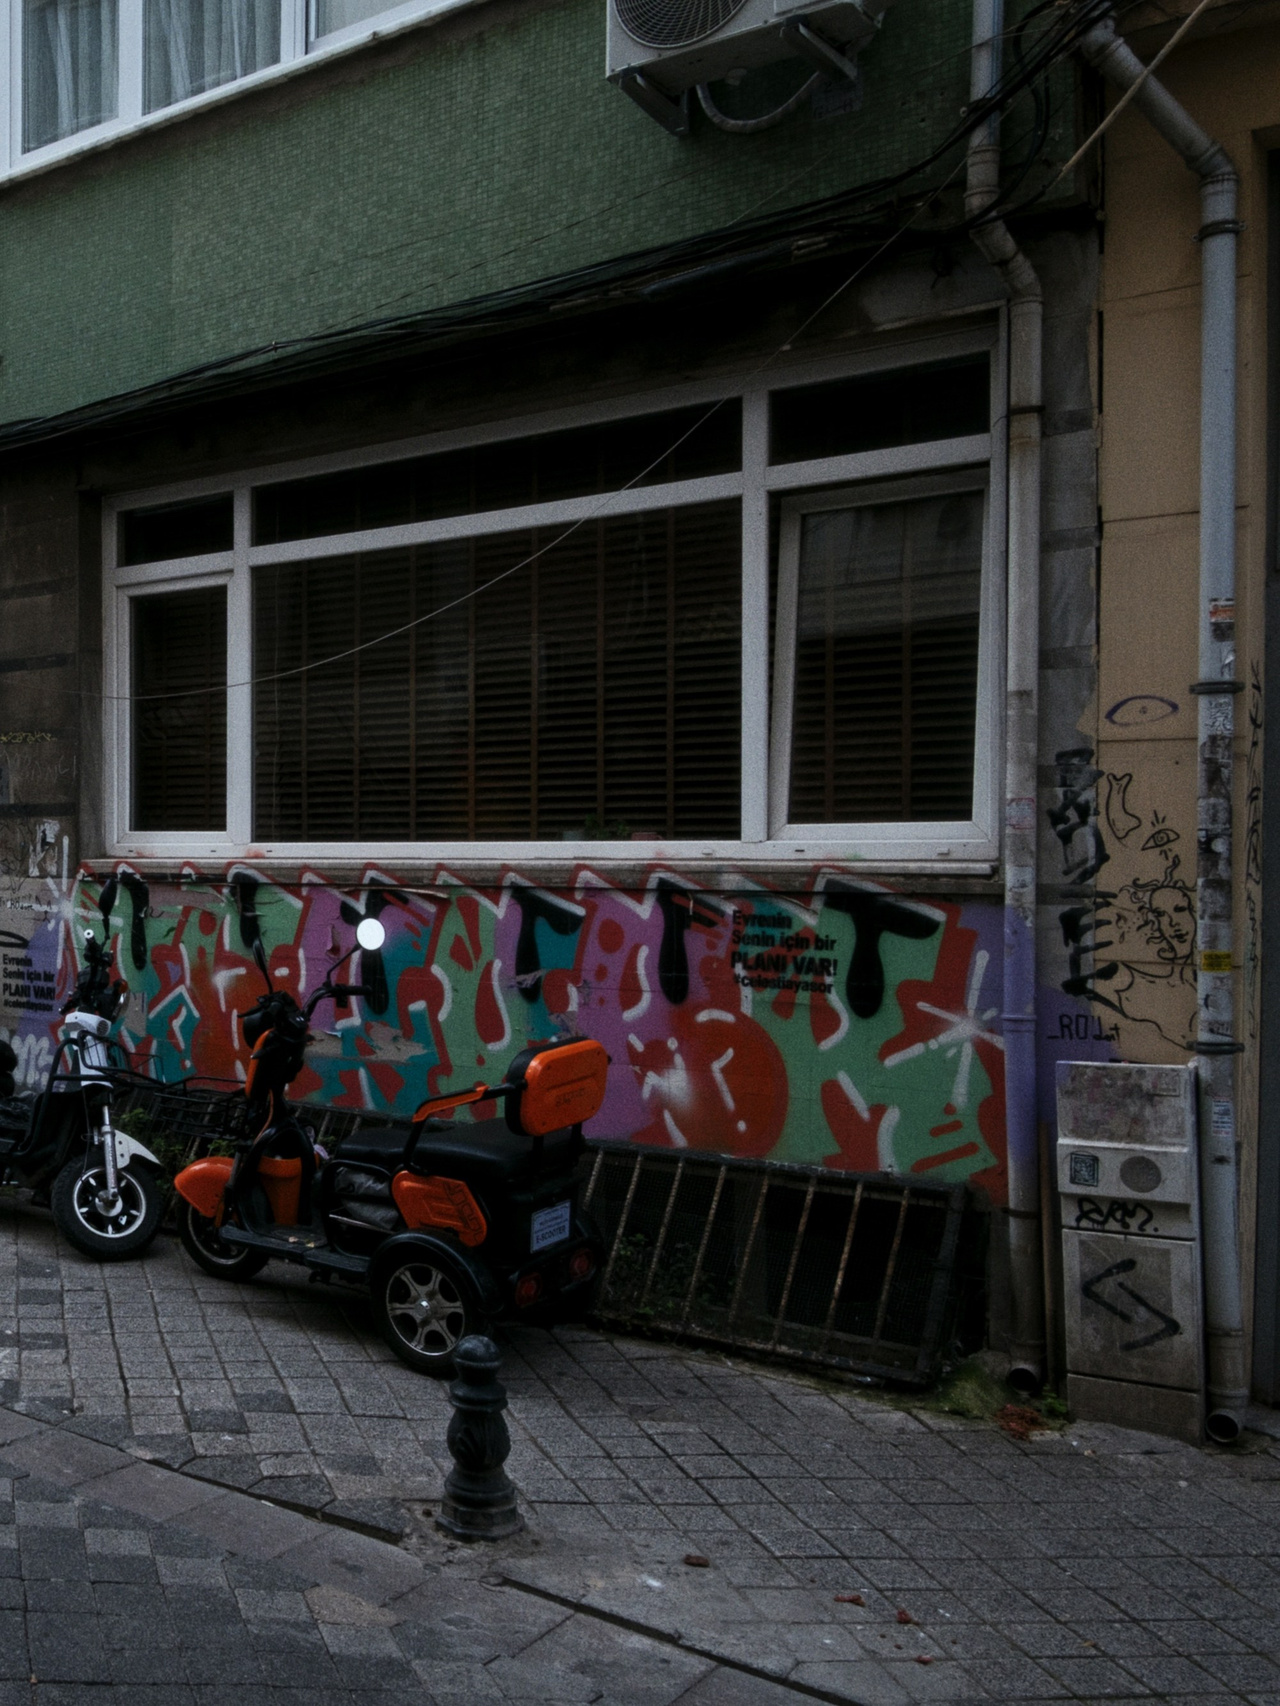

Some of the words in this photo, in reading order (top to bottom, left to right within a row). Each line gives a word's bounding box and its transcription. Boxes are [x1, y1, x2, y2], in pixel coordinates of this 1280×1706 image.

[733, 910, 792, 929] Evrenin
[732, 930, 775, 947] Senin
[780, 933, 810, 951] için
[815, 935, 837, 951] bir
[3, 953, 33, 967] Evrenin
[731, 952, 787, 973] PLANI
[793, 956, 838, 976] VAR!
[3, 968, 24, 981] Senin
[26, 970, 41, 984] için
[43, 970, 55, 983] bir
[3, 983, 31, 998] PLANI
